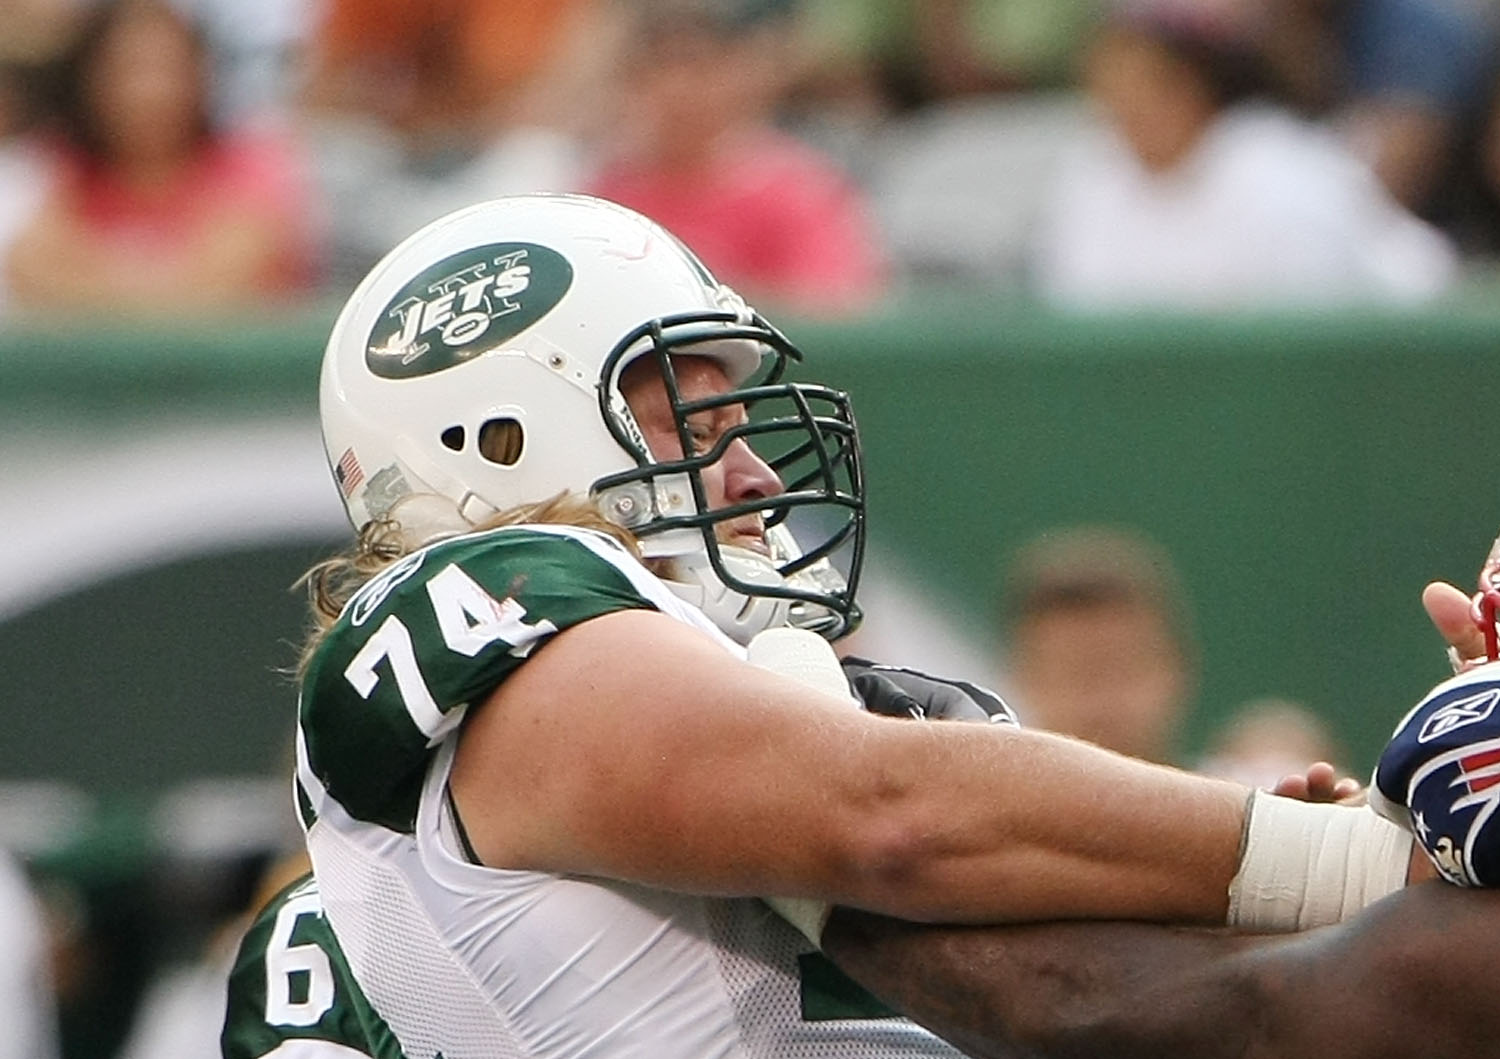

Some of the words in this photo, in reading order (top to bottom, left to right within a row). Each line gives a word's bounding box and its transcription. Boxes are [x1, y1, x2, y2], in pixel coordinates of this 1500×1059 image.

[387, 265, 531, 348] JETS
[343, 562, 559, 749] 74
[265, 890, 335, 1027] 6
